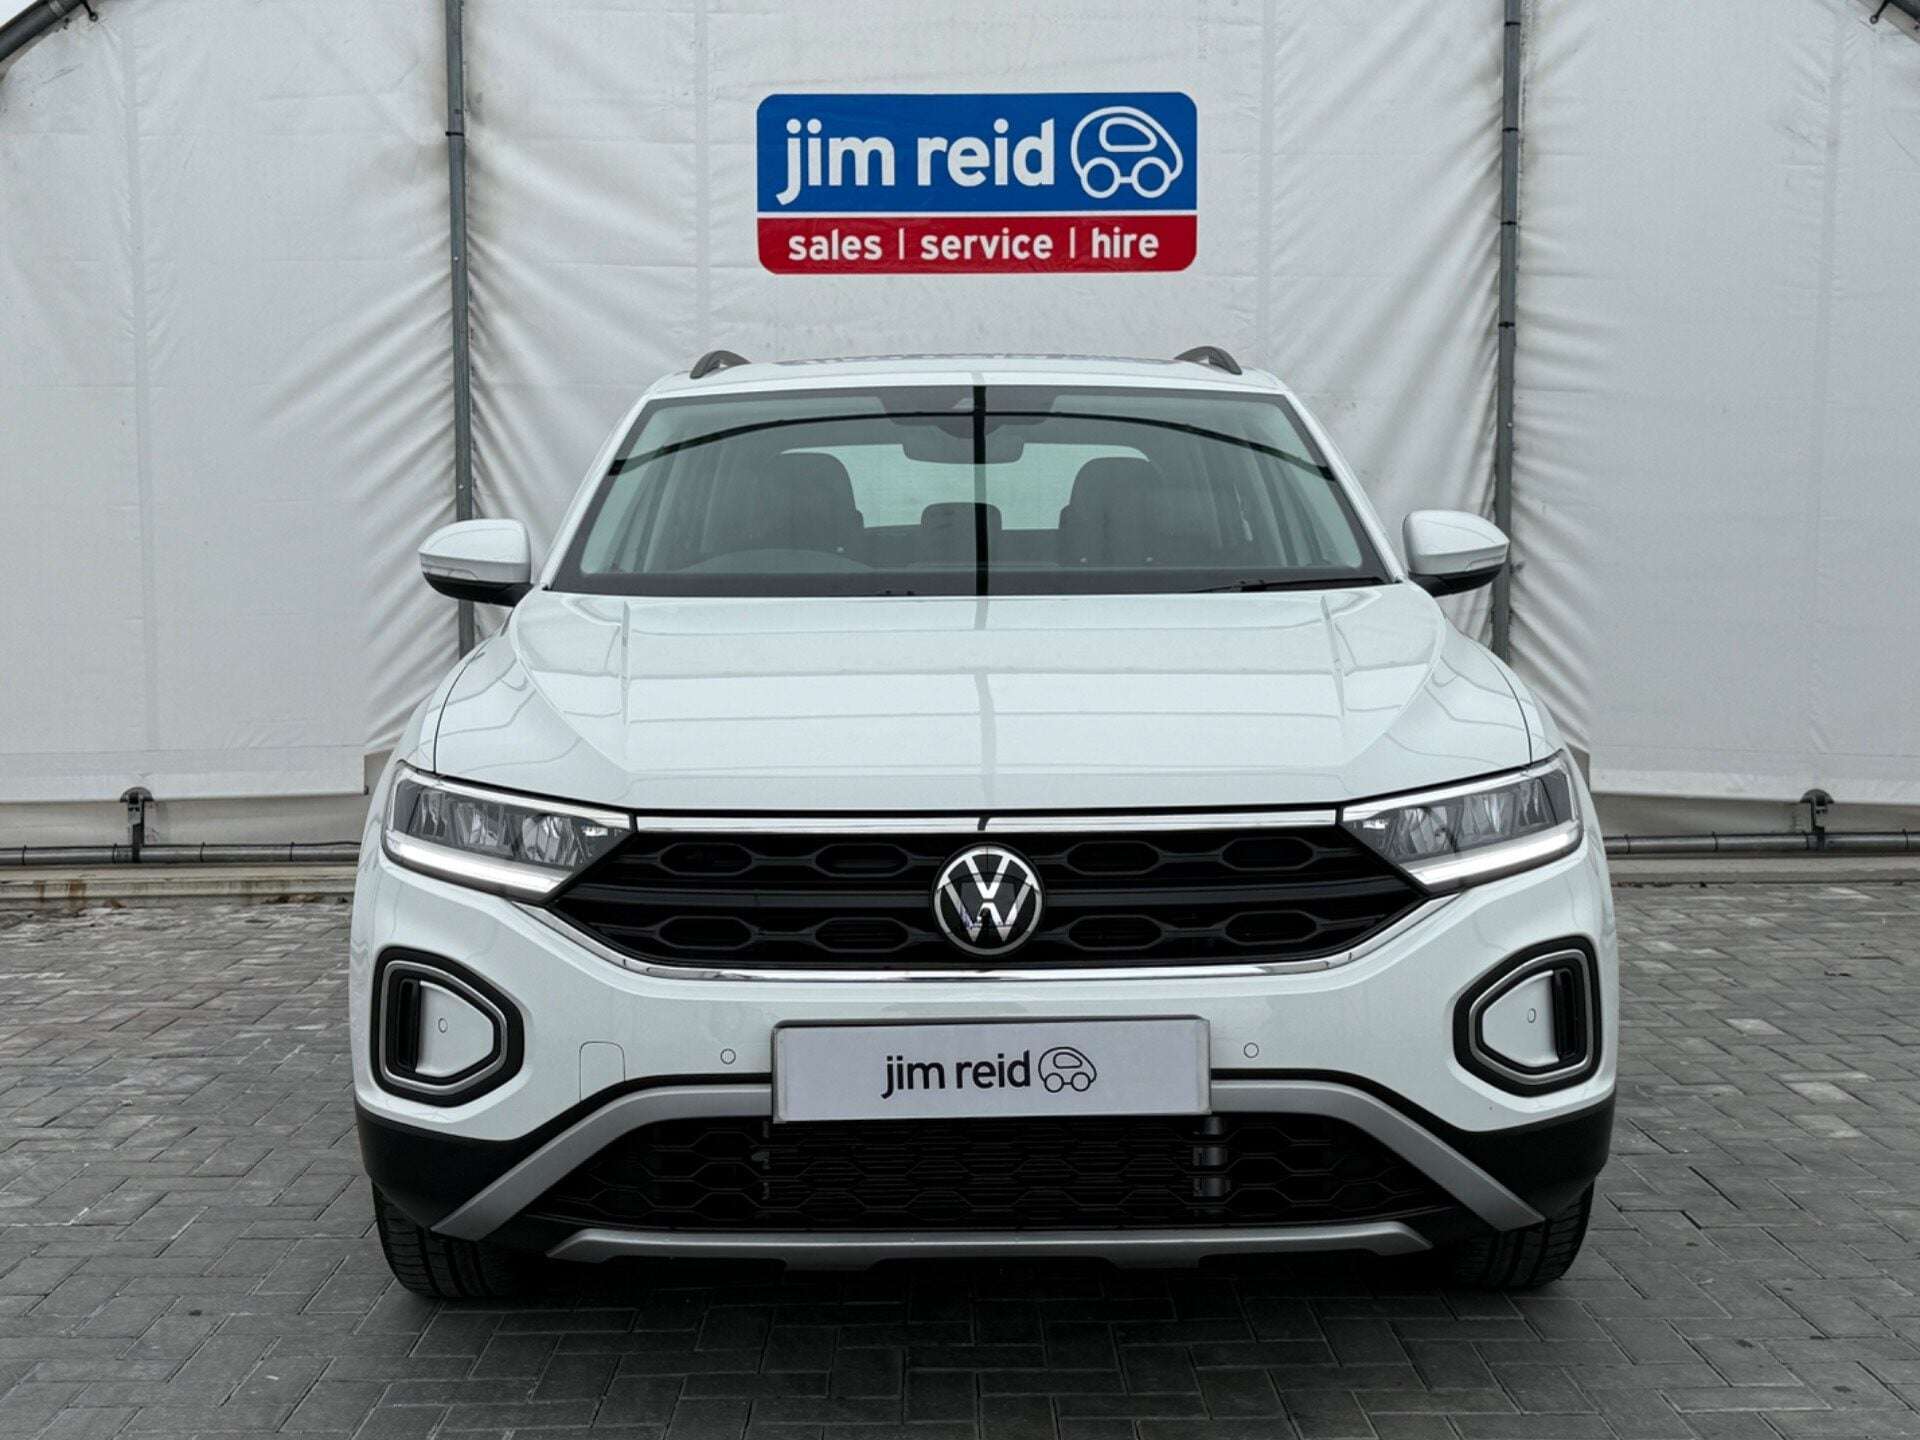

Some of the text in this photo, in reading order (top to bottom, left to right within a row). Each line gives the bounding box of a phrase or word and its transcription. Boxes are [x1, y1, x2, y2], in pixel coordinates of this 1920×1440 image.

[776, 117, 1054, 206] jim reid
[788, 225, 1159, 261] sales service hire
[937, 847, 1039, 951] VW
[881, 1050, 1031, 1098] jim reid
